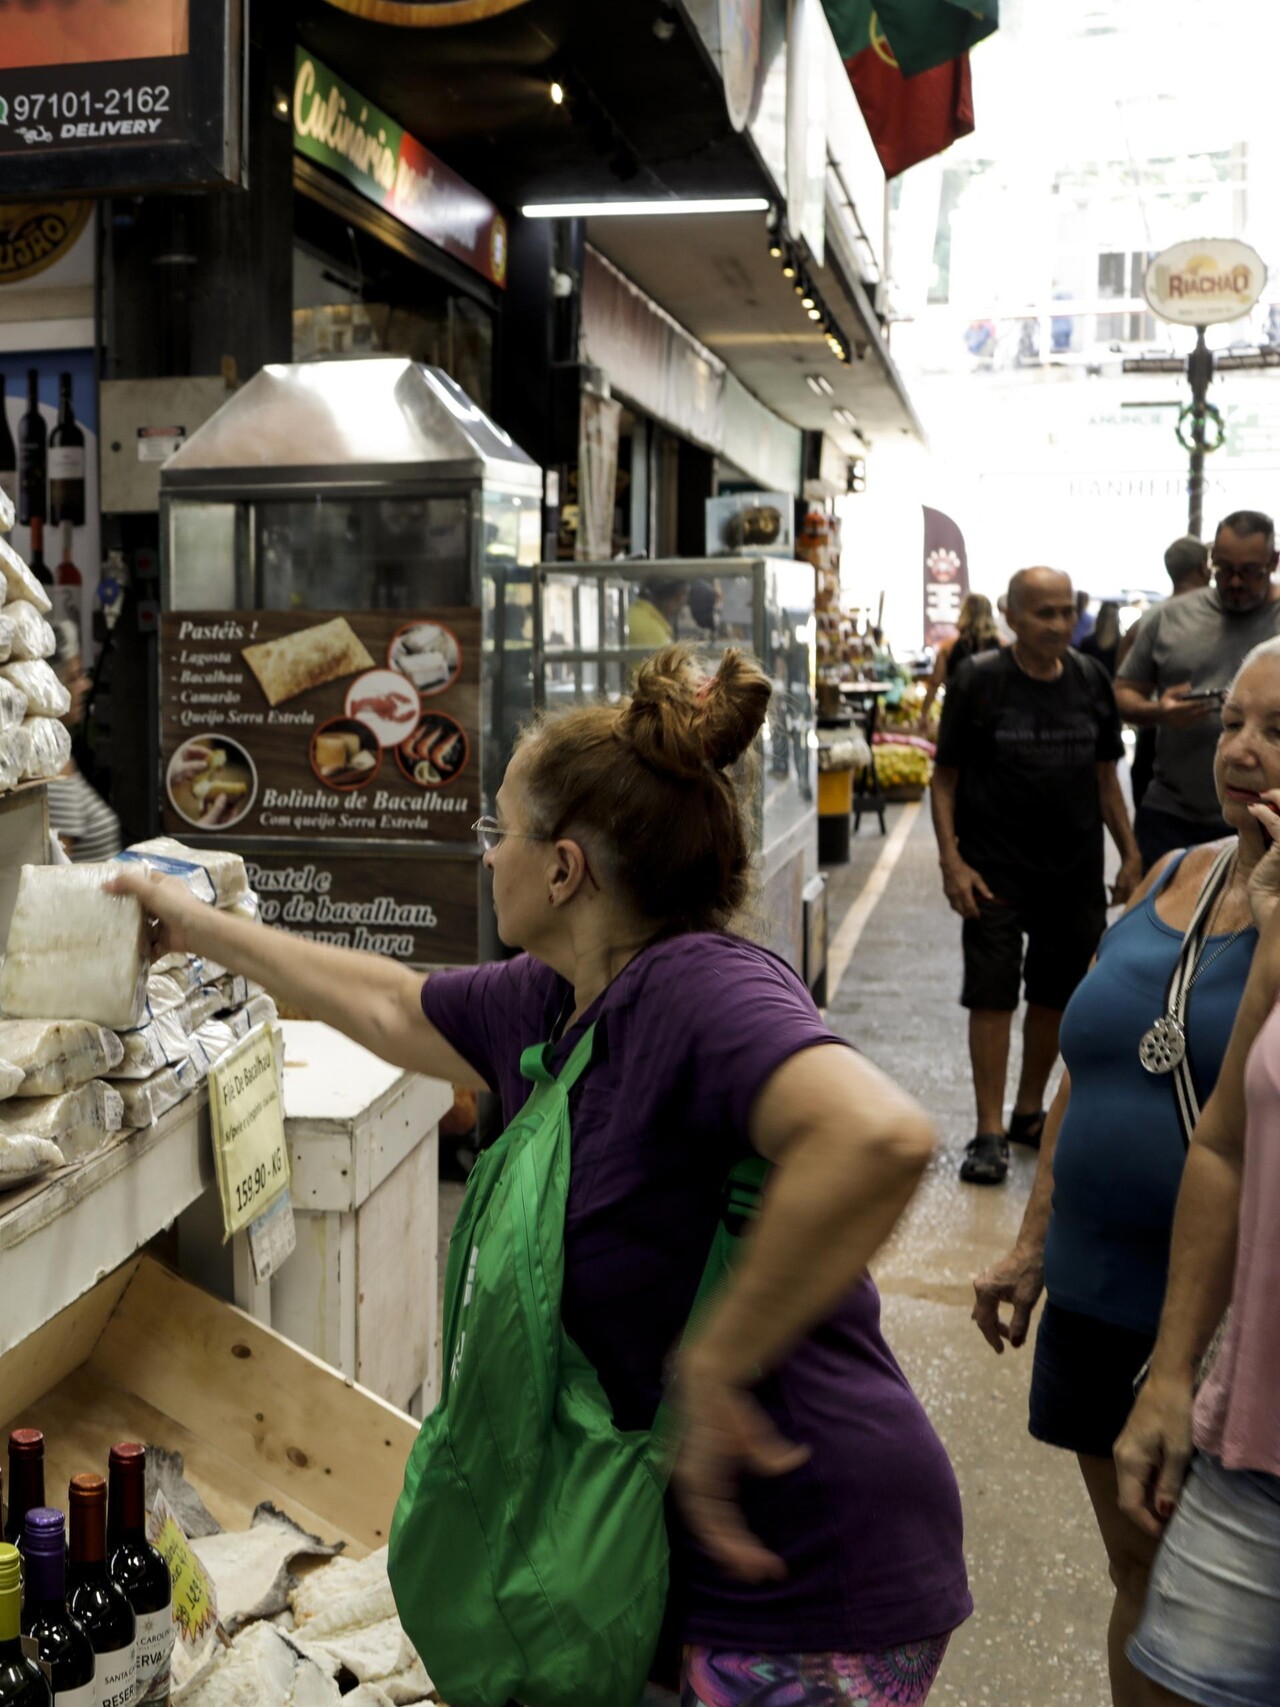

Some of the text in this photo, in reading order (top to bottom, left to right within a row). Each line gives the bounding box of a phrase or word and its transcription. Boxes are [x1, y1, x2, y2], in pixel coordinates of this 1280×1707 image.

[14, 85, 170, 120] 97101-2162
[60, 118, 161, 139] DELIVERY
[180, 650, 232, 666] Lagosta
[180, 670, 243, 683] Bacalhau
[181, 709, 315, 726] Queijo Serra Estrela
[262, 788, 468, 812] Bolinho de Bacalhau
[259, 812, 428, 829] Com queijo Serra Estrela
[245, 863, 332, 892] Pastel e
[283, 893, 315, 921] de
[354, 926, 414, 956] hora
[272, 1147, 281, 1179] KG
